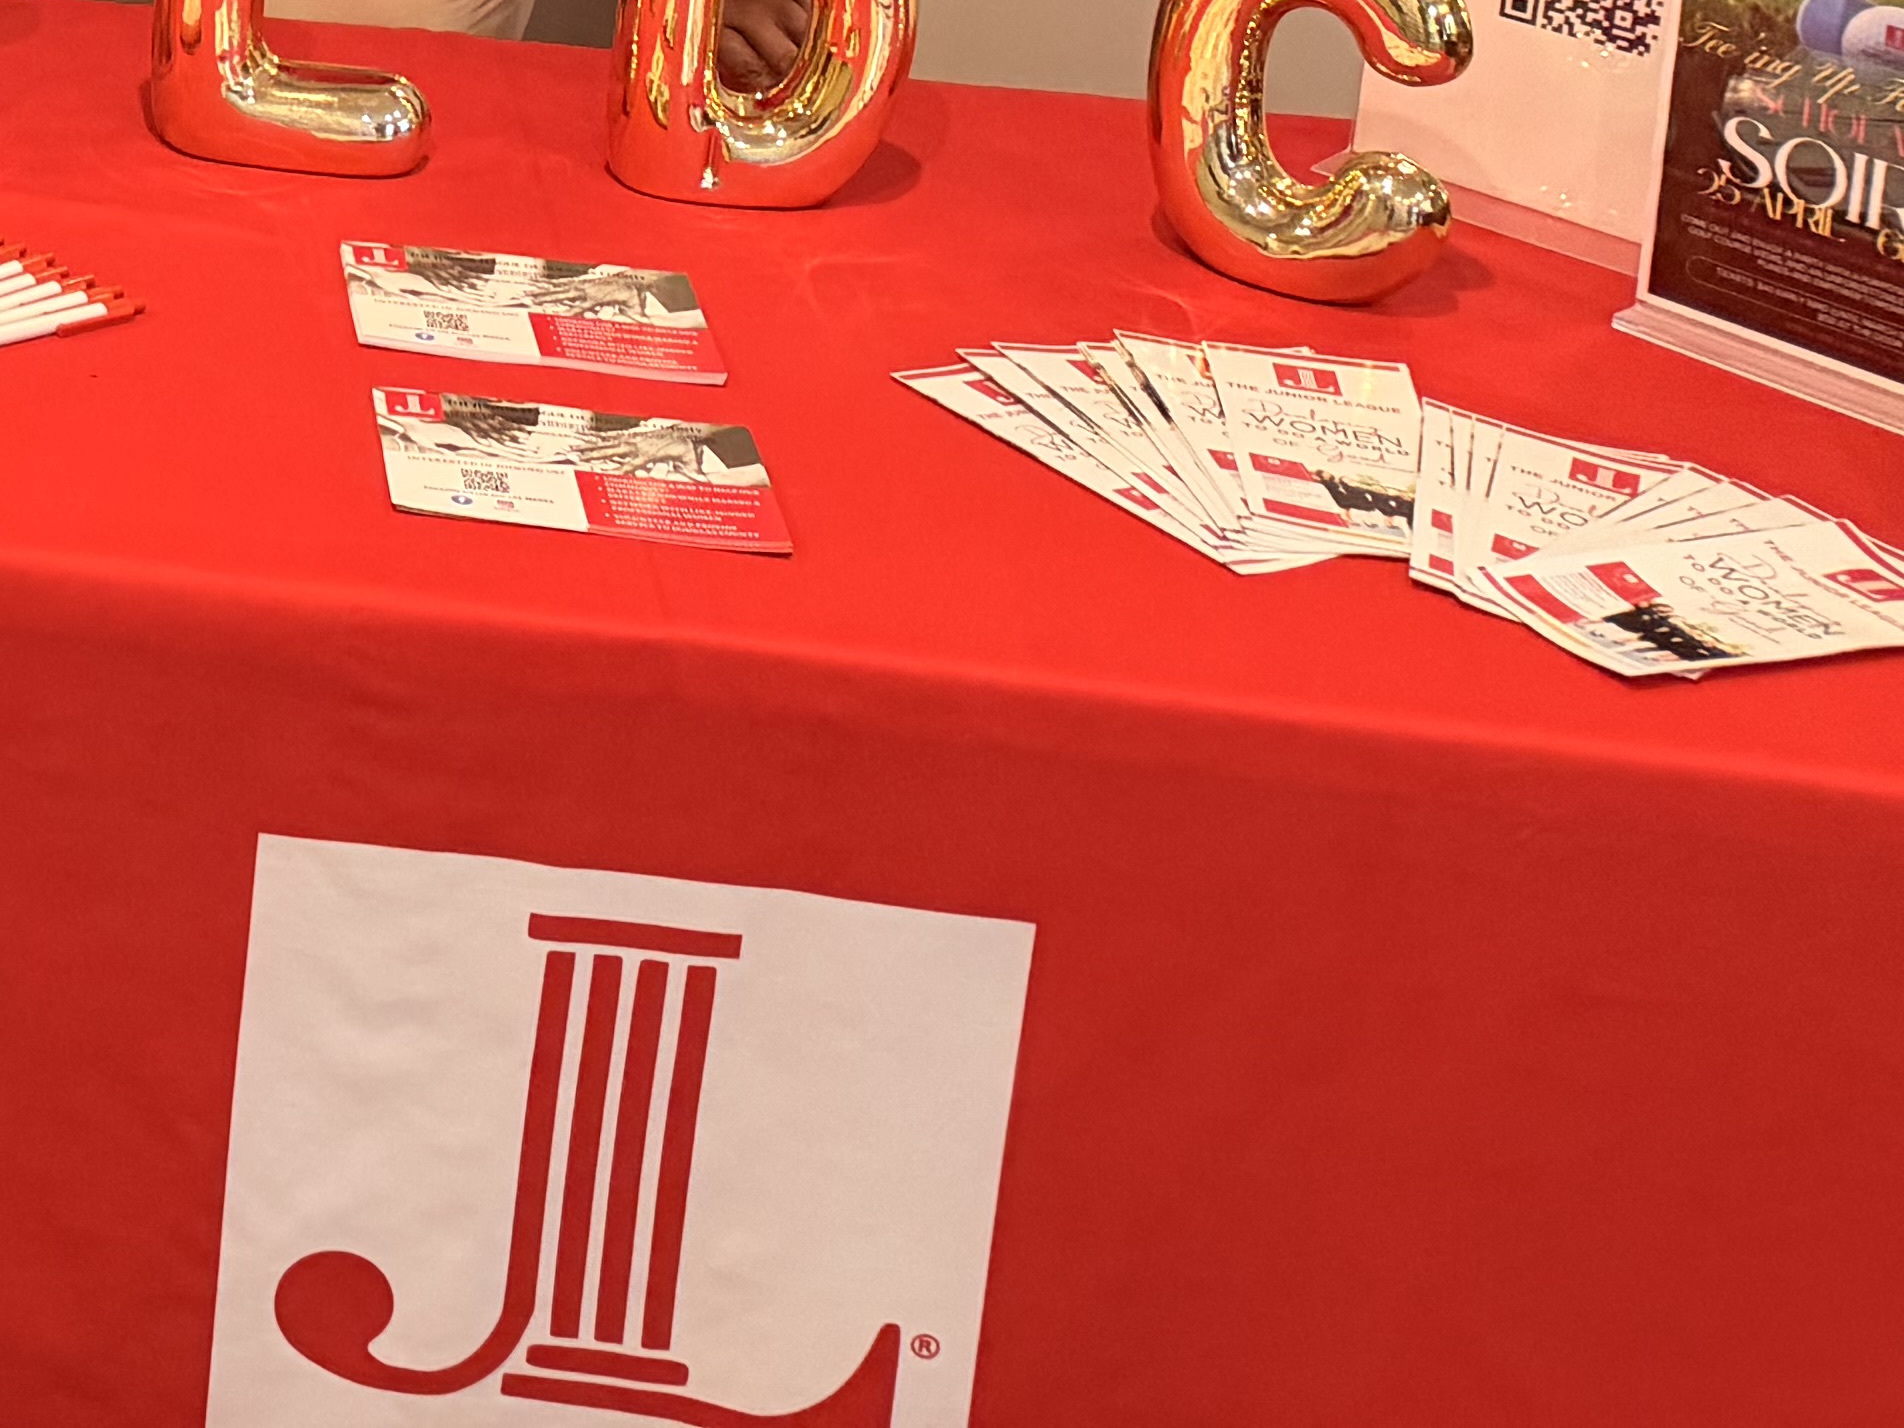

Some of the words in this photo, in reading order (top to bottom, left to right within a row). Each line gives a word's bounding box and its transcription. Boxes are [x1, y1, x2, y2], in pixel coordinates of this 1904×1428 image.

[1226, 380, 1261, 393] THE
[1265, 388, 1328, 403] JUNIOR
[1332, 398, 1402, 415] LEAGUE
[1248, 411, 1403, 449] WOMEN
[1510, 464, 1544, 480] THE
[1549, 478, 1618, 503] JUNIOR
[1708, 556, 1847, 637] WOMEN
